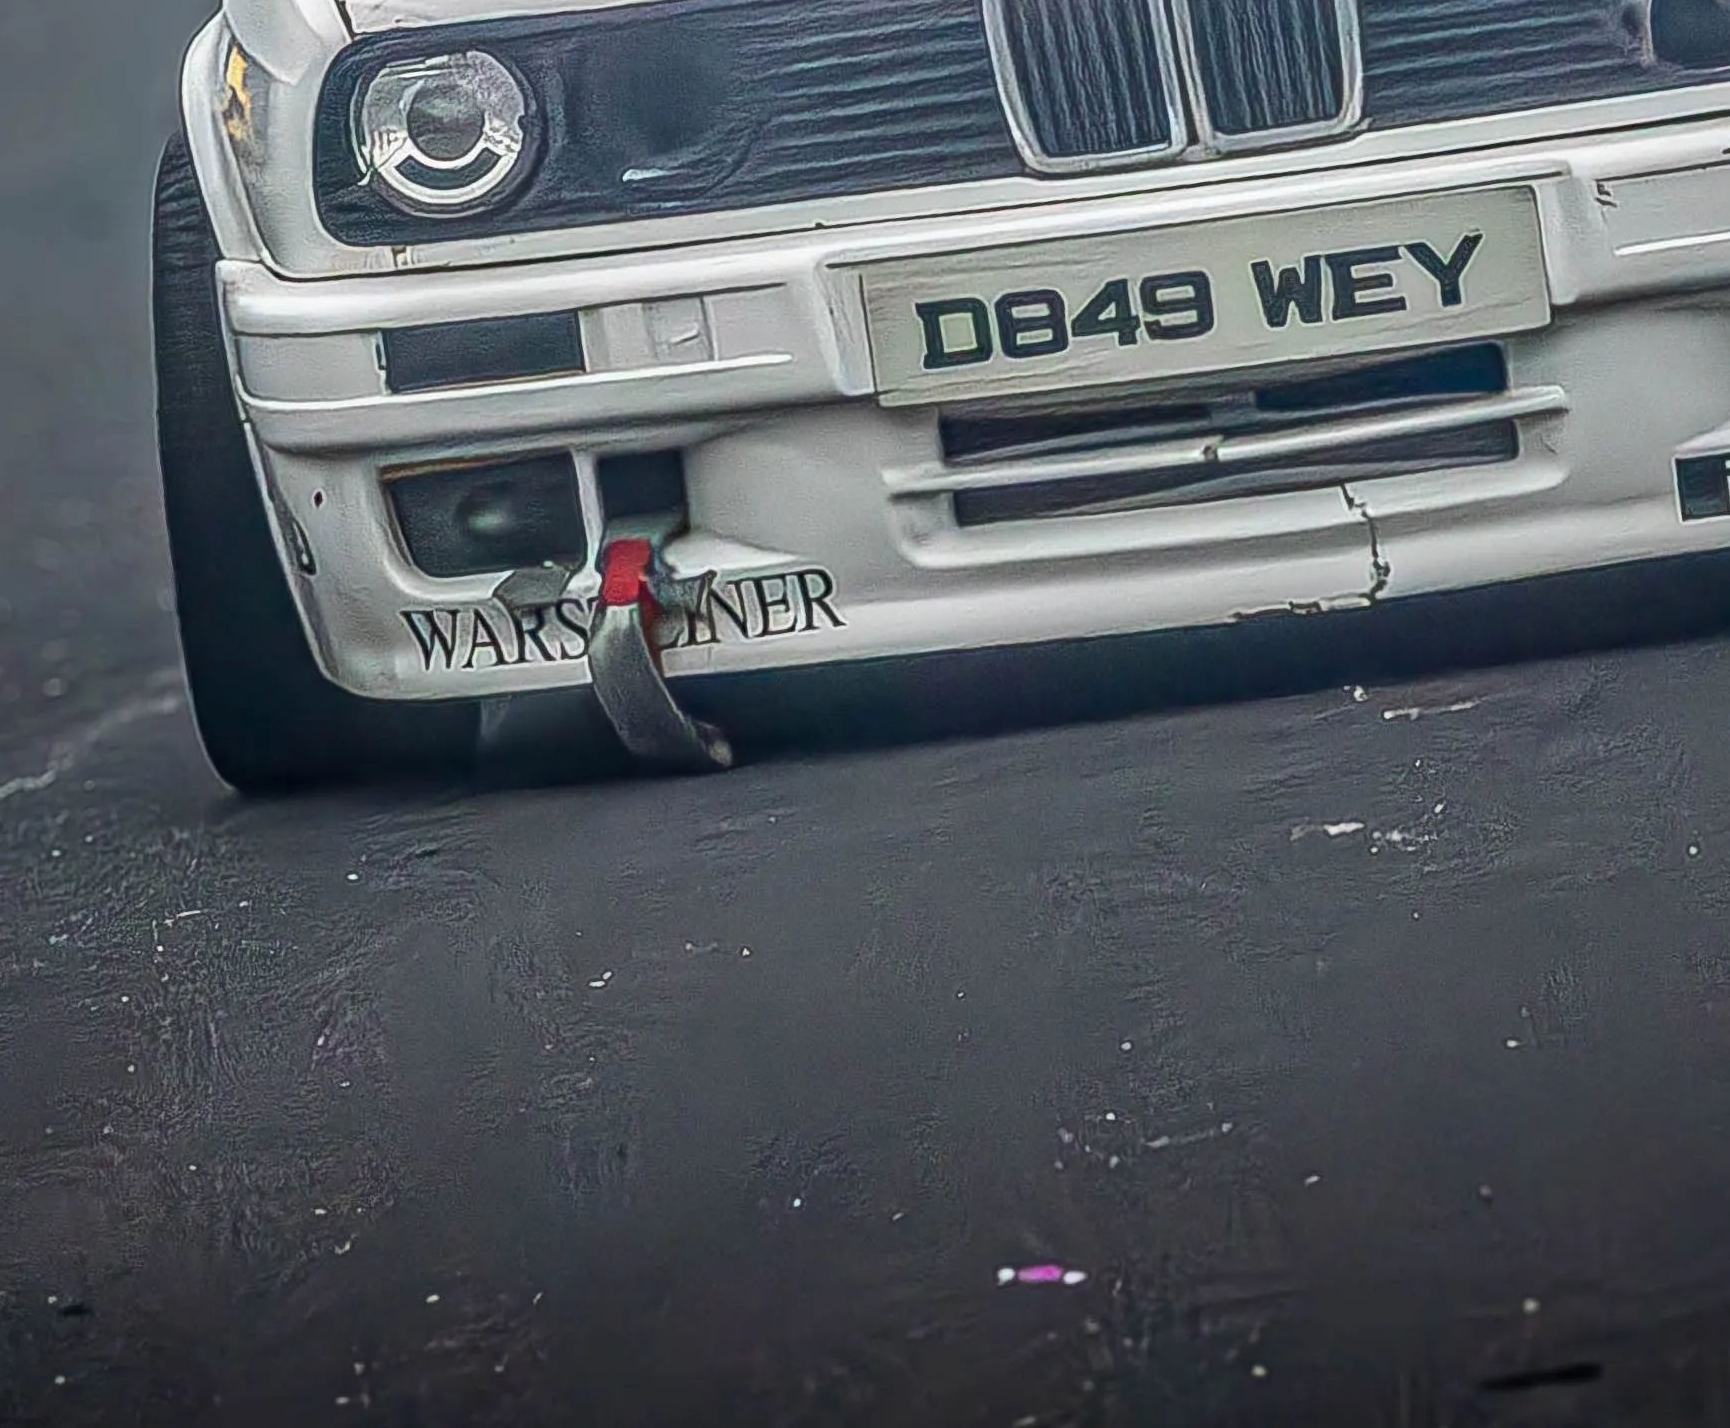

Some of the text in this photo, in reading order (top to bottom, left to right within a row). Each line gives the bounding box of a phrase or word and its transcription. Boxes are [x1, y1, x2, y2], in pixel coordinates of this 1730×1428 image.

[915, 233, 1484, 371] D849 WEY
[400, 567, 848, 672] WARSINER
